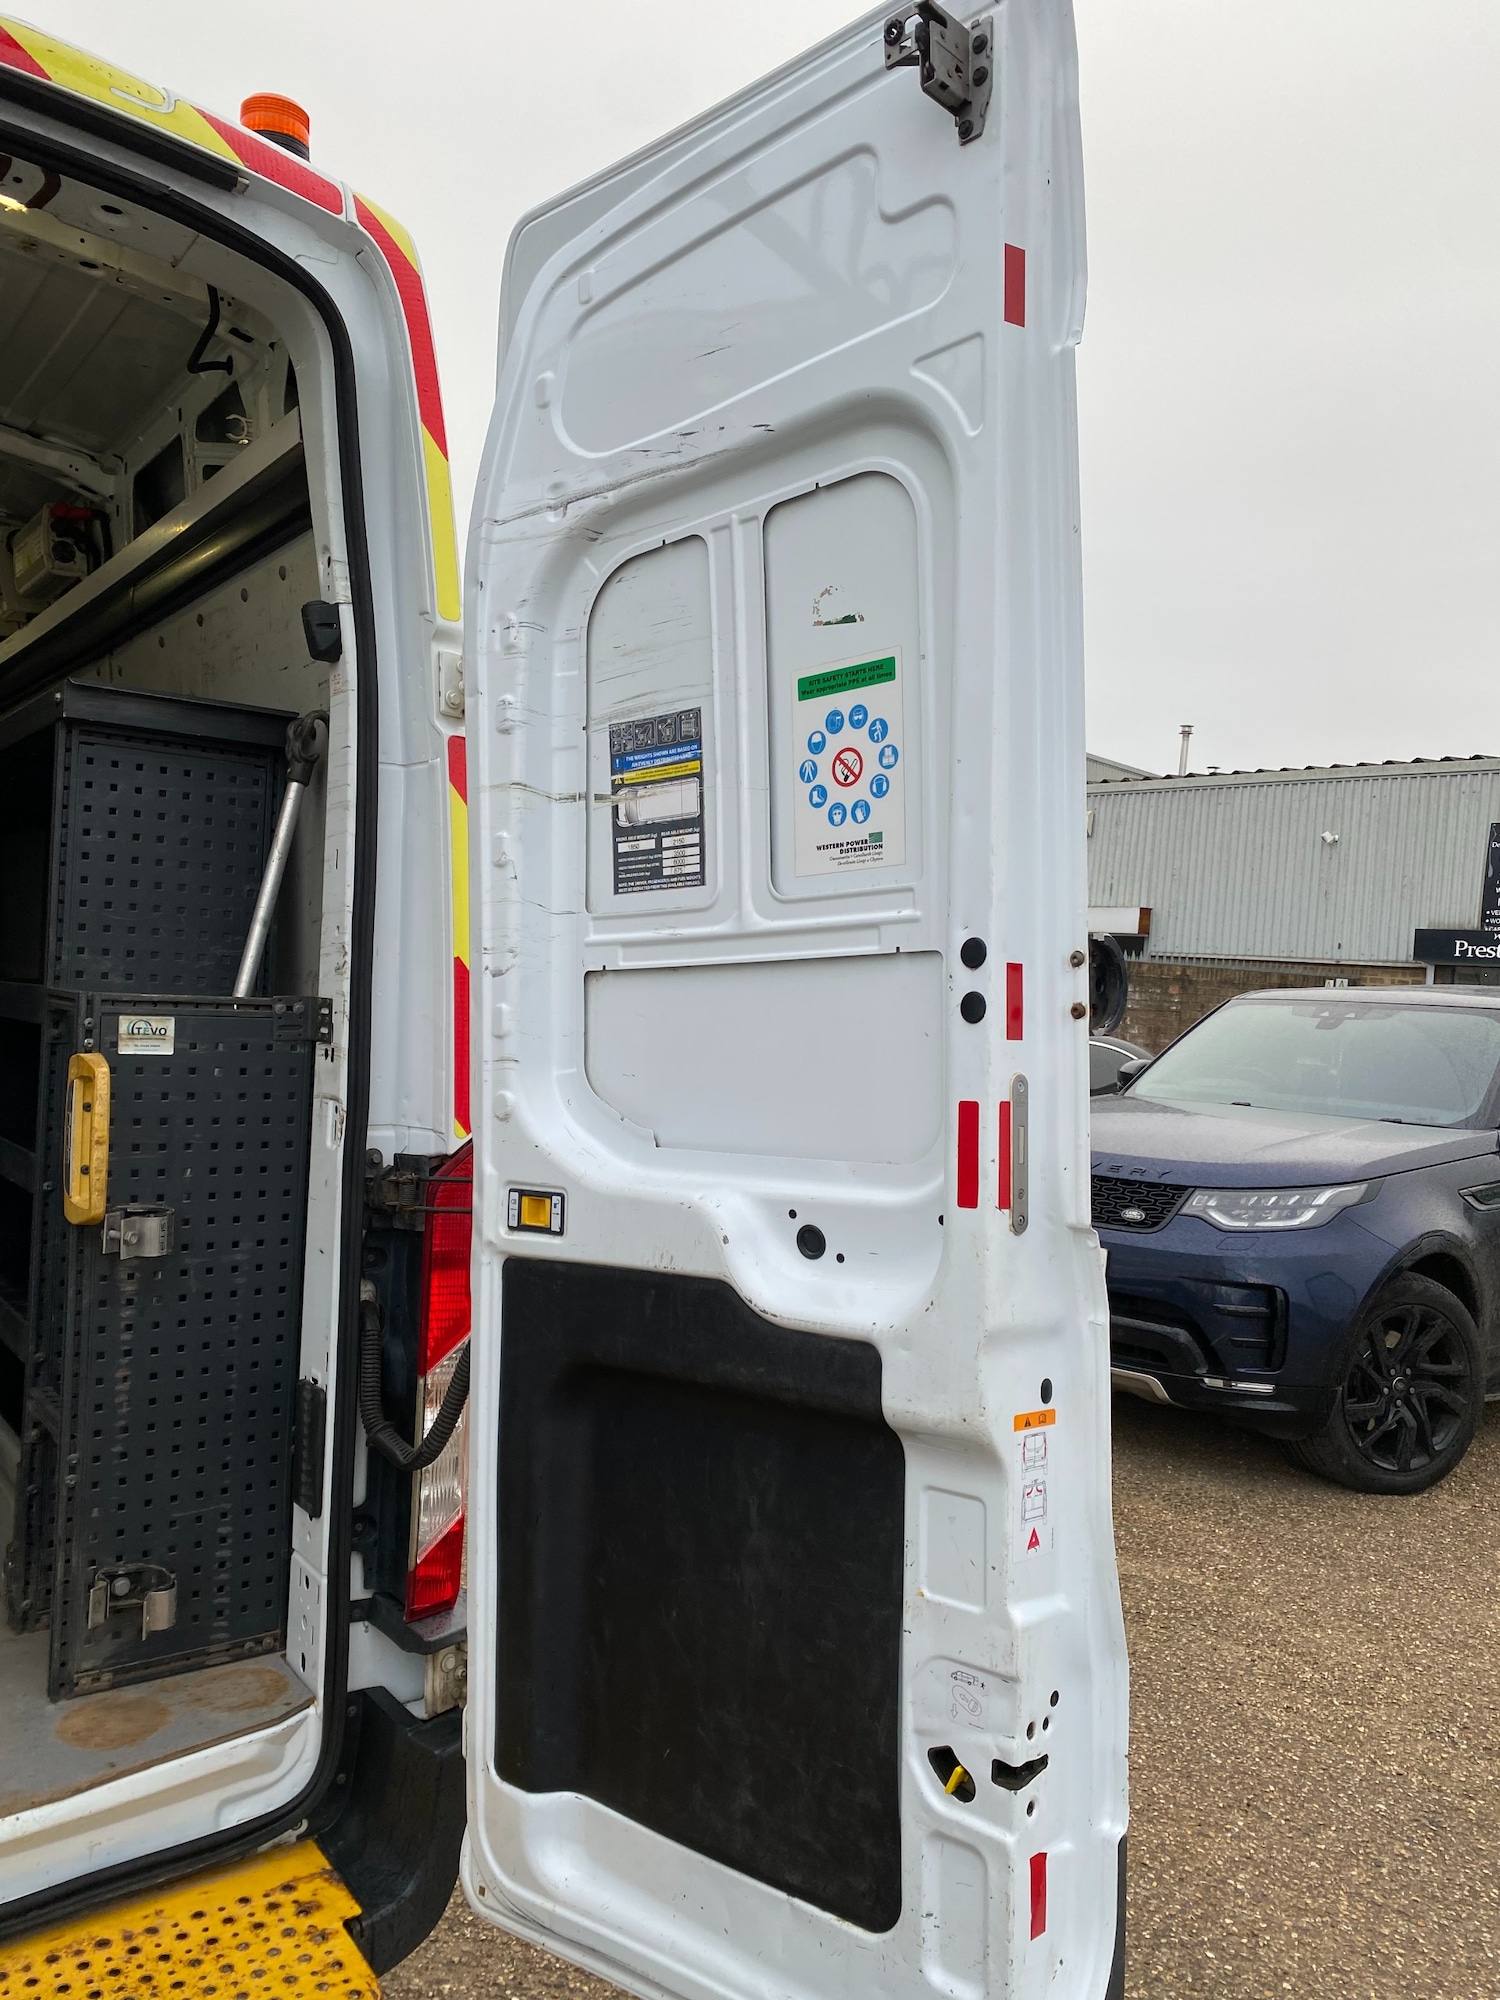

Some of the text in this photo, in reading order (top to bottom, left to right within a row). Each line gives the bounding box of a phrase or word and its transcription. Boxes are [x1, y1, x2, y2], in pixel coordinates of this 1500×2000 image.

[808, 664, 884, 686] SITE SAFETY STARTS HERE
[816, 682, 847, 693] appropriate
[634, 752, 653, 761] WEIGHTS
[653, 750, 668, 758] SHOWN
[816, 839, 868, 851] WESTERN POWER
[840, 844, 883, 854] DISTRIBUTION
[135, 1027, 167, 1036] TEVO
[1091, 1162, 1172, 1178] ERY
